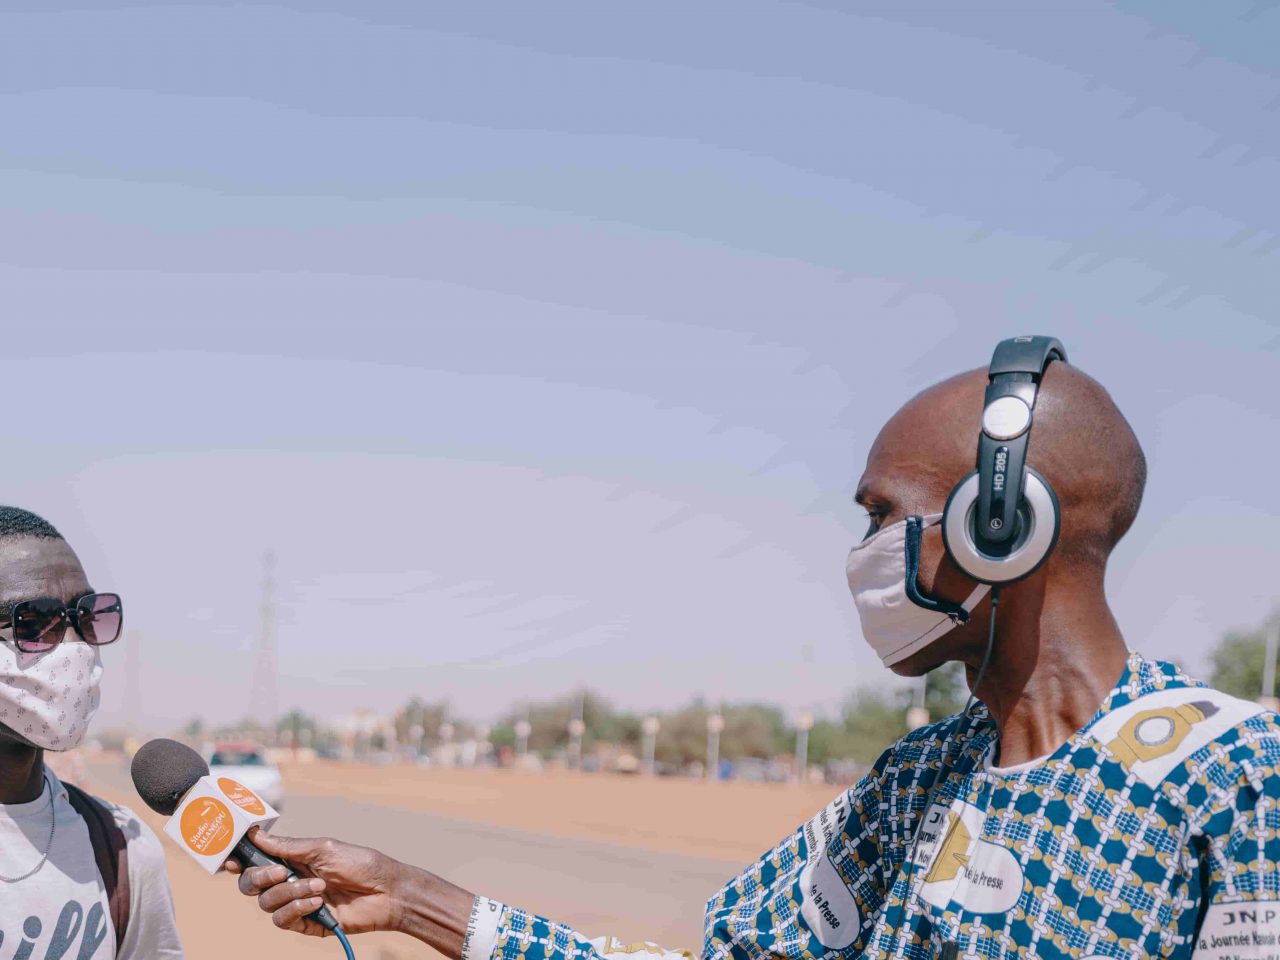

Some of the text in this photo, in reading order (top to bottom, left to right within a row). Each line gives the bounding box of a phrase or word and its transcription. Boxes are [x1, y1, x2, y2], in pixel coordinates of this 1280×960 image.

[993, 452, 1007, 491] HD 205
[979, 871, 1004, 890] Presse
[819, 900, 841, 930] Presse
[1211, 931, 1250, 948] Journée
